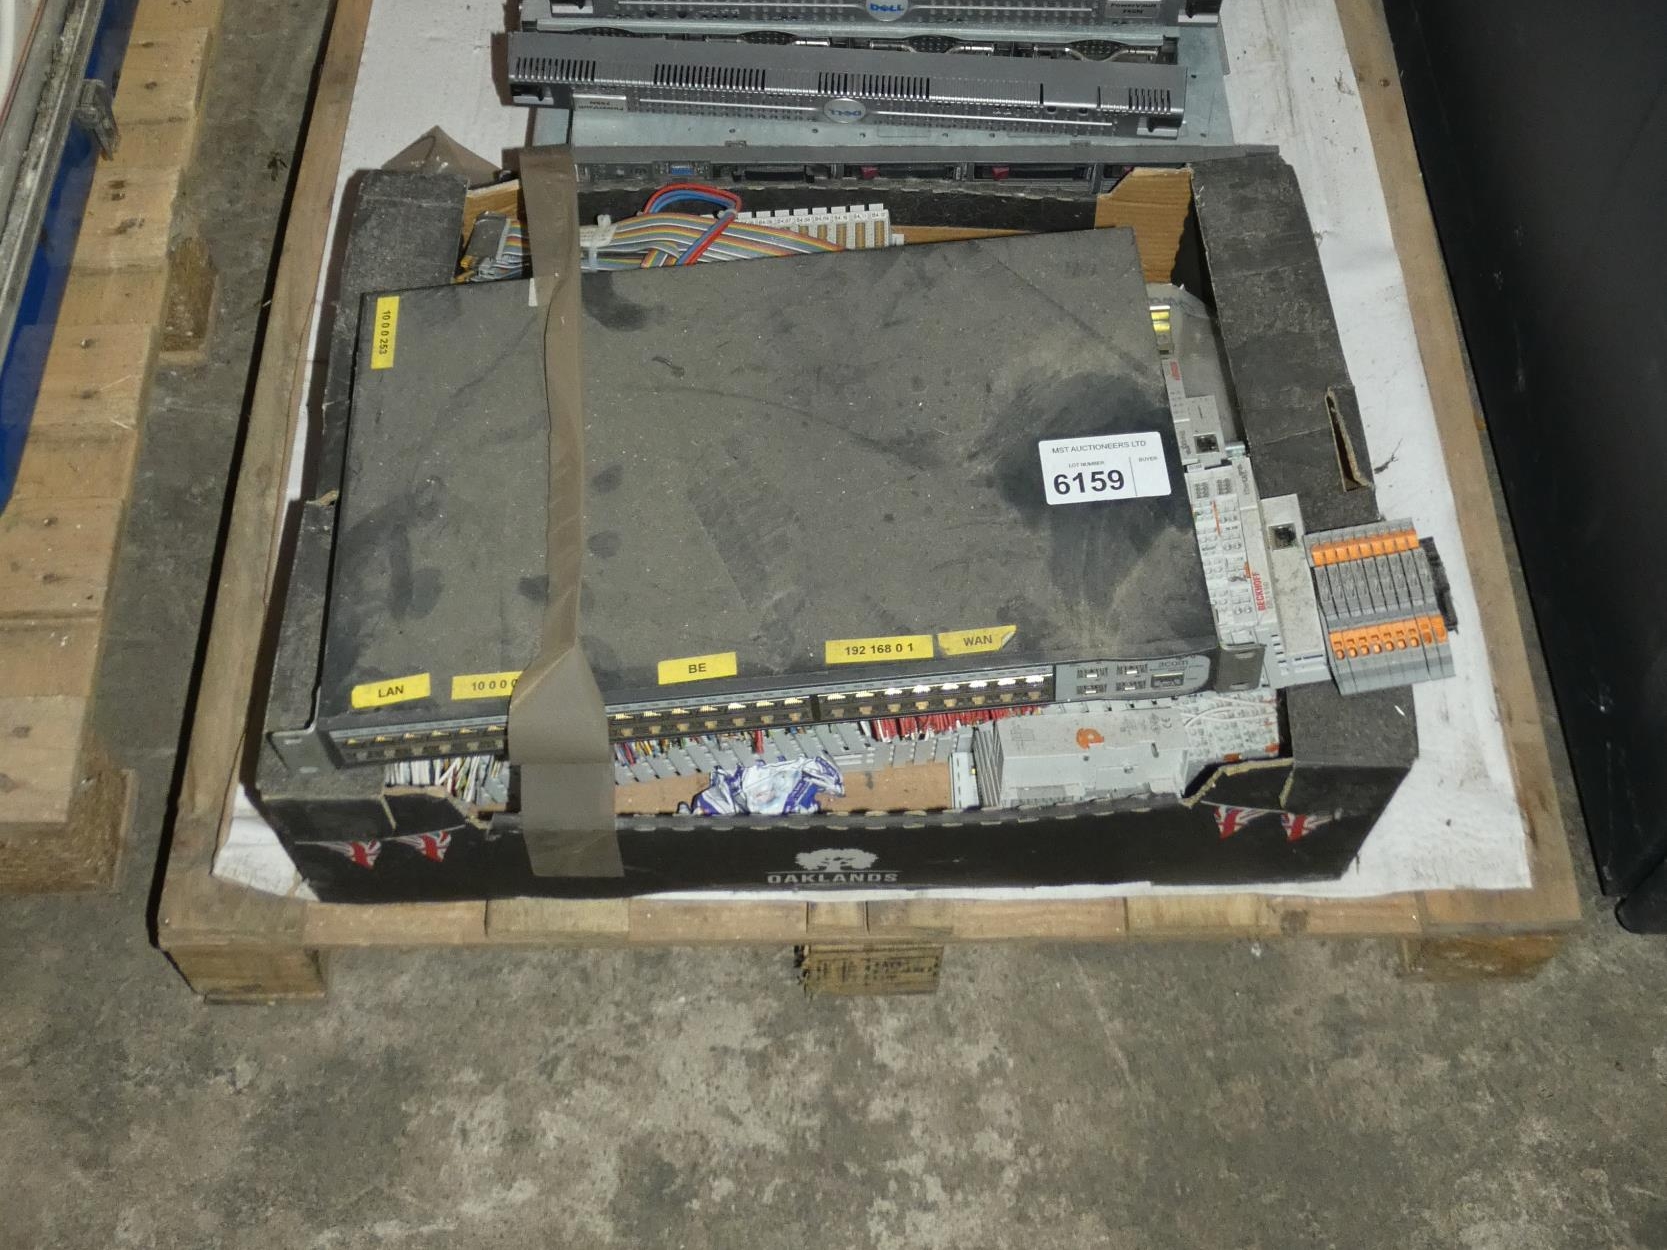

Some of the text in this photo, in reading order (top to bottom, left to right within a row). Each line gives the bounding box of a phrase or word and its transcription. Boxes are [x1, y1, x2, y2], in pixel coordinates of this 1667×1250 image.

[869, 2, 905, 12] DELL
[382, 310, 391, 320] 10
[1052, 440, 1147, 454] MST AUCTIONEERS LTD
[1053, 469, 1125, 495] 6159
[1251, 572, 1267, 612] BECKHOFF
[963, 634, 993, 647] WAN
[844, 642, 914, 656] 192 168 0 1
[688, 662, 707, 674] BE
[377, 684, 405, 699] LAN
[472, 681, 486, 691] 10
[488, 680, 496, 689] 0
[499, 679, 507, 689] 0
[766, 872, 899, 884] OAKLANDS
